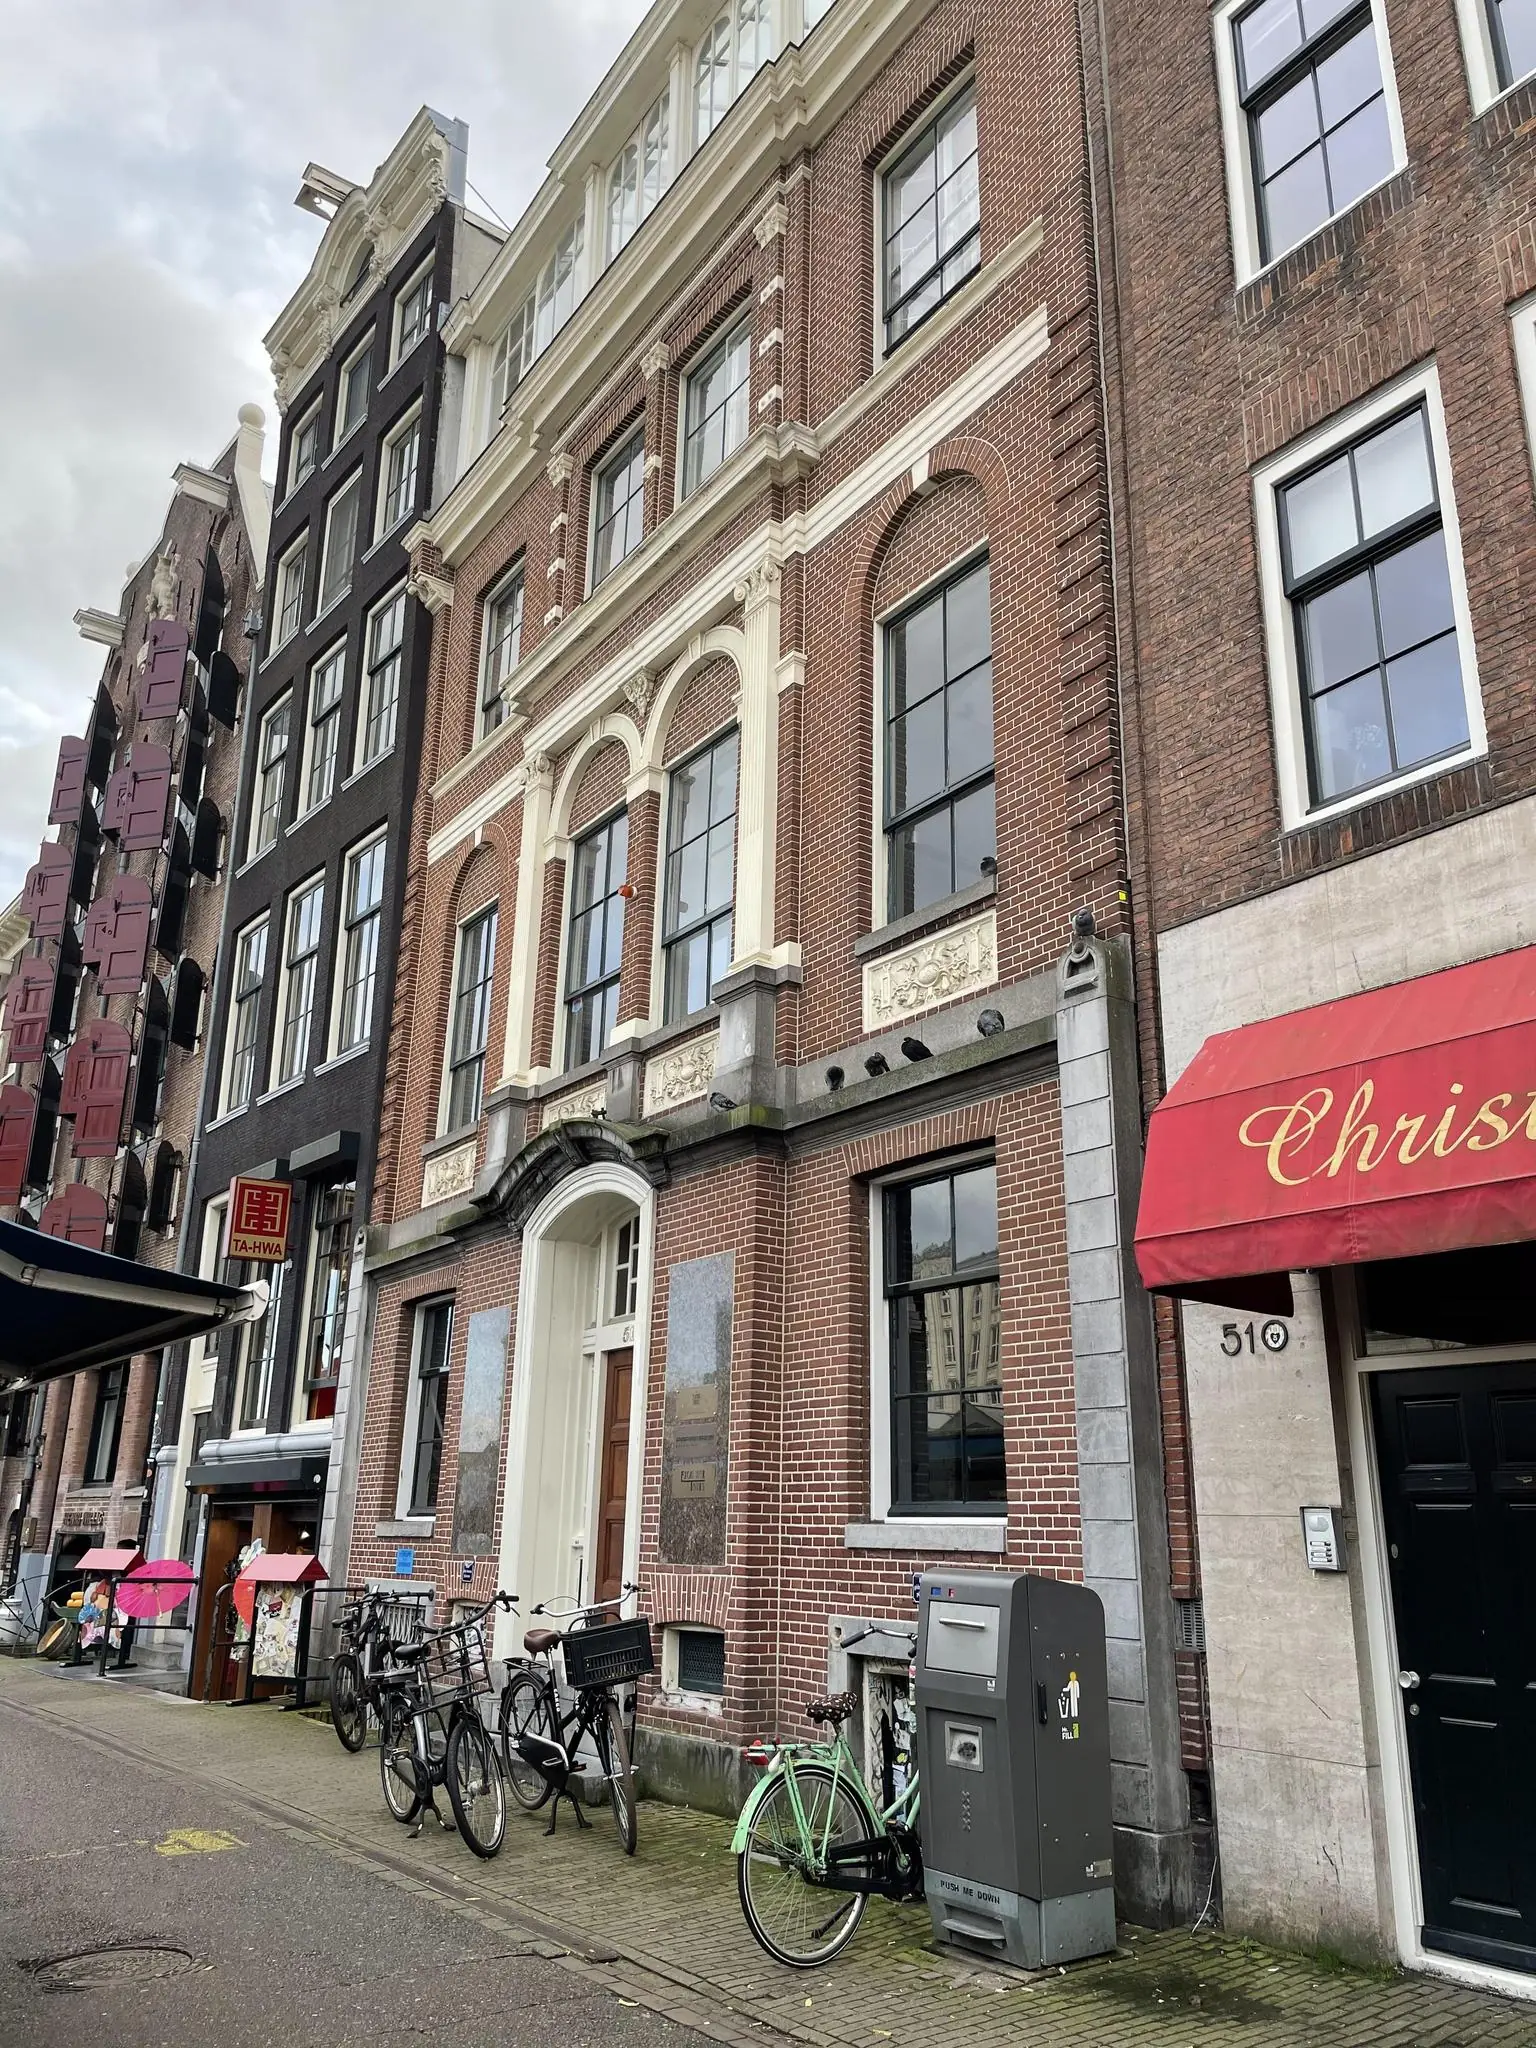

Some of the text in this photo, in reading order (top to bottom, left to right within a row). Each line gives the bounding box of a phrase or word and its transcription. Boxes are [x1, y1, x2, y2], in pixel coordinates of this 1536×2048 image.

[233, 1239, 282, 1255] TA-HWA
[1220, 1319, 1288, 1356] 510
[1062, 1731, 1074, 1740] FILL
[940, 1880, 1000, 1904] PUSH ME DOWN
